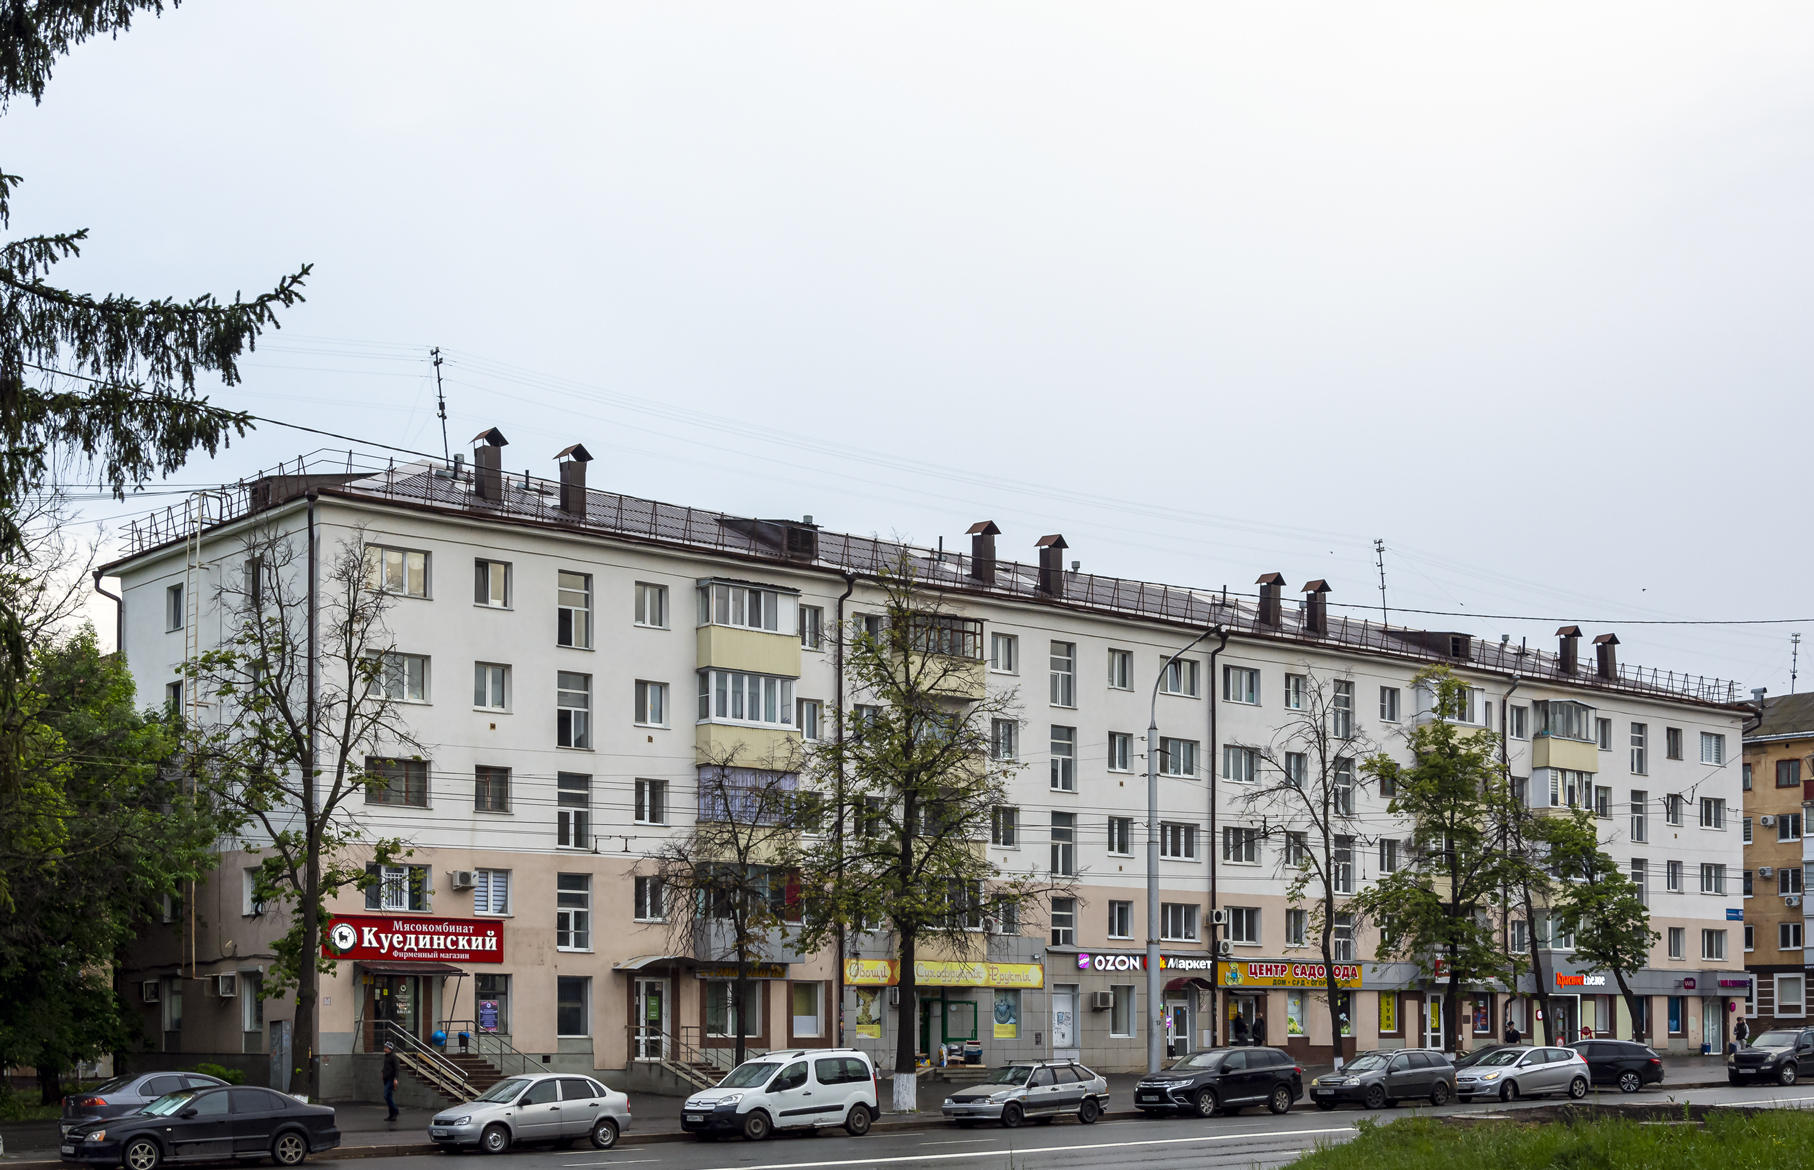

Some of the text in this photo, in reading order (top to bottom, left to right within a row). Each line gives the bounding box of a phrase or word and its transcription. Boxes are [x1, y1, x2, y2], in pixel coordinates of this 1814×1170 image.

[392, 920, 475, 934] Мясокомбинат
[361, 927, 498, 954] Куединский
[392, 950, 470, 960] Фирменный магазин
[1094, 955, 1140, 971] OZON
[848, 961, 888, 982] Овощи
[1167, 958, 1213, 971] Маркет
[1248, 962, 1359, 980] ЦЕНТР САДООДА
[989, 964, 1032, 985] Фрукты
[1272, 978, 1287, 986] ДОМ
[1292, 979, 1305, 987] САД
